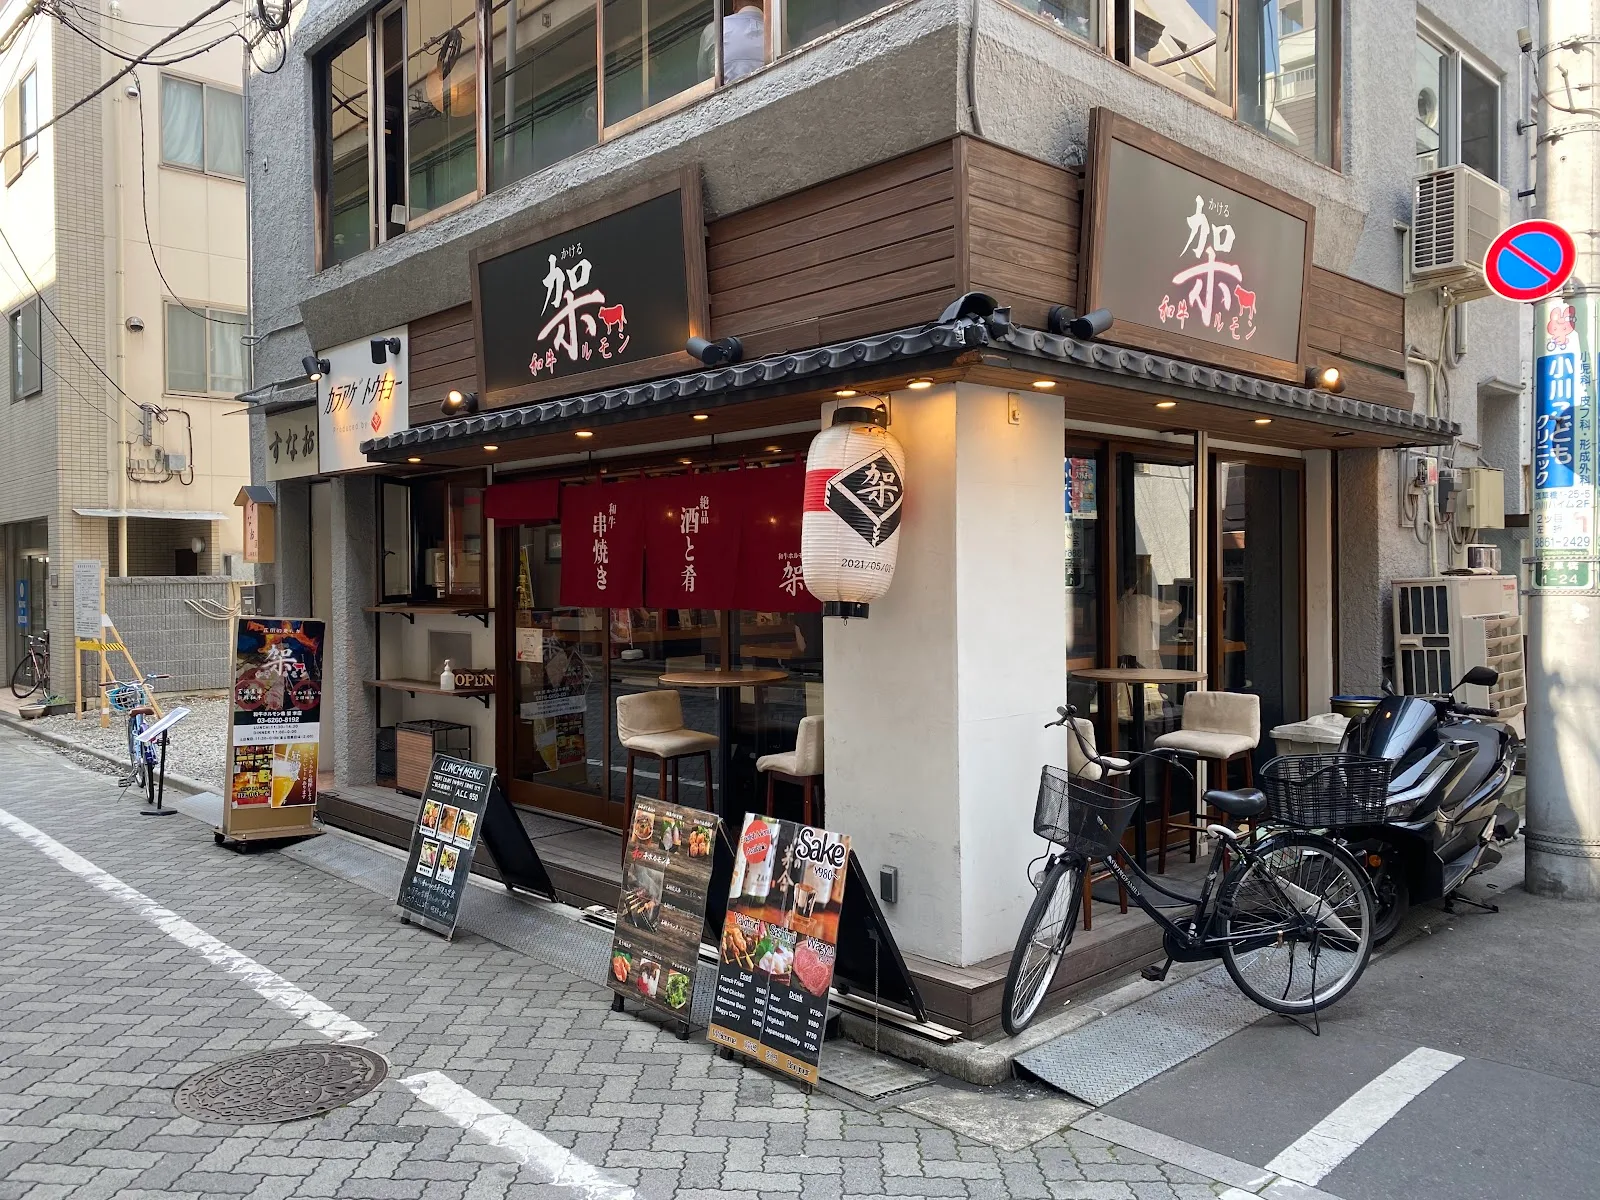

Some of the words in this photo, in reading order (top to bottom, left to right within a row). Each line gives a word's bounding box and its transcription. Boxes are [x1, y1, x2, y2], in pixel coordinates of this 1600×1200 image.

[1208, 198, 1230, 217] かける
[560, 242, 583, 260] かける
[1172, 194, 1243, 327] 架
[537, 254, 605, 361] 架
[1158, 294, 1190, 330] 和牛
[529, 348, 558, 377] 和牛
[333, 423, 359, 434] Produced
[361, 421, 369, 430] by
[268, 424, 315, 465] すなお
[1536, 414, 1549, 487] クリニック
[856, 463, 899, 508] 架
[608, 502, 617, 529] 和牛
[700, 495, 710, 525] 絶品
[592, 511, 609, 591] 串焼き
[680, 505, 700, 592] 酒と肴
[1535, 536, 1591, 548] 3861-2429
[779, 561, 805, 597] 架
[1542, 574, 1578, 585] 1-24
[455, 674, 495, 687] OPEN
[440, 760, 463, 775] LUNCH
[462, 767, 483, 780] MENU
[796, 827, 845, 868] Sake
[806, 935, 834, 957] Wagyu
